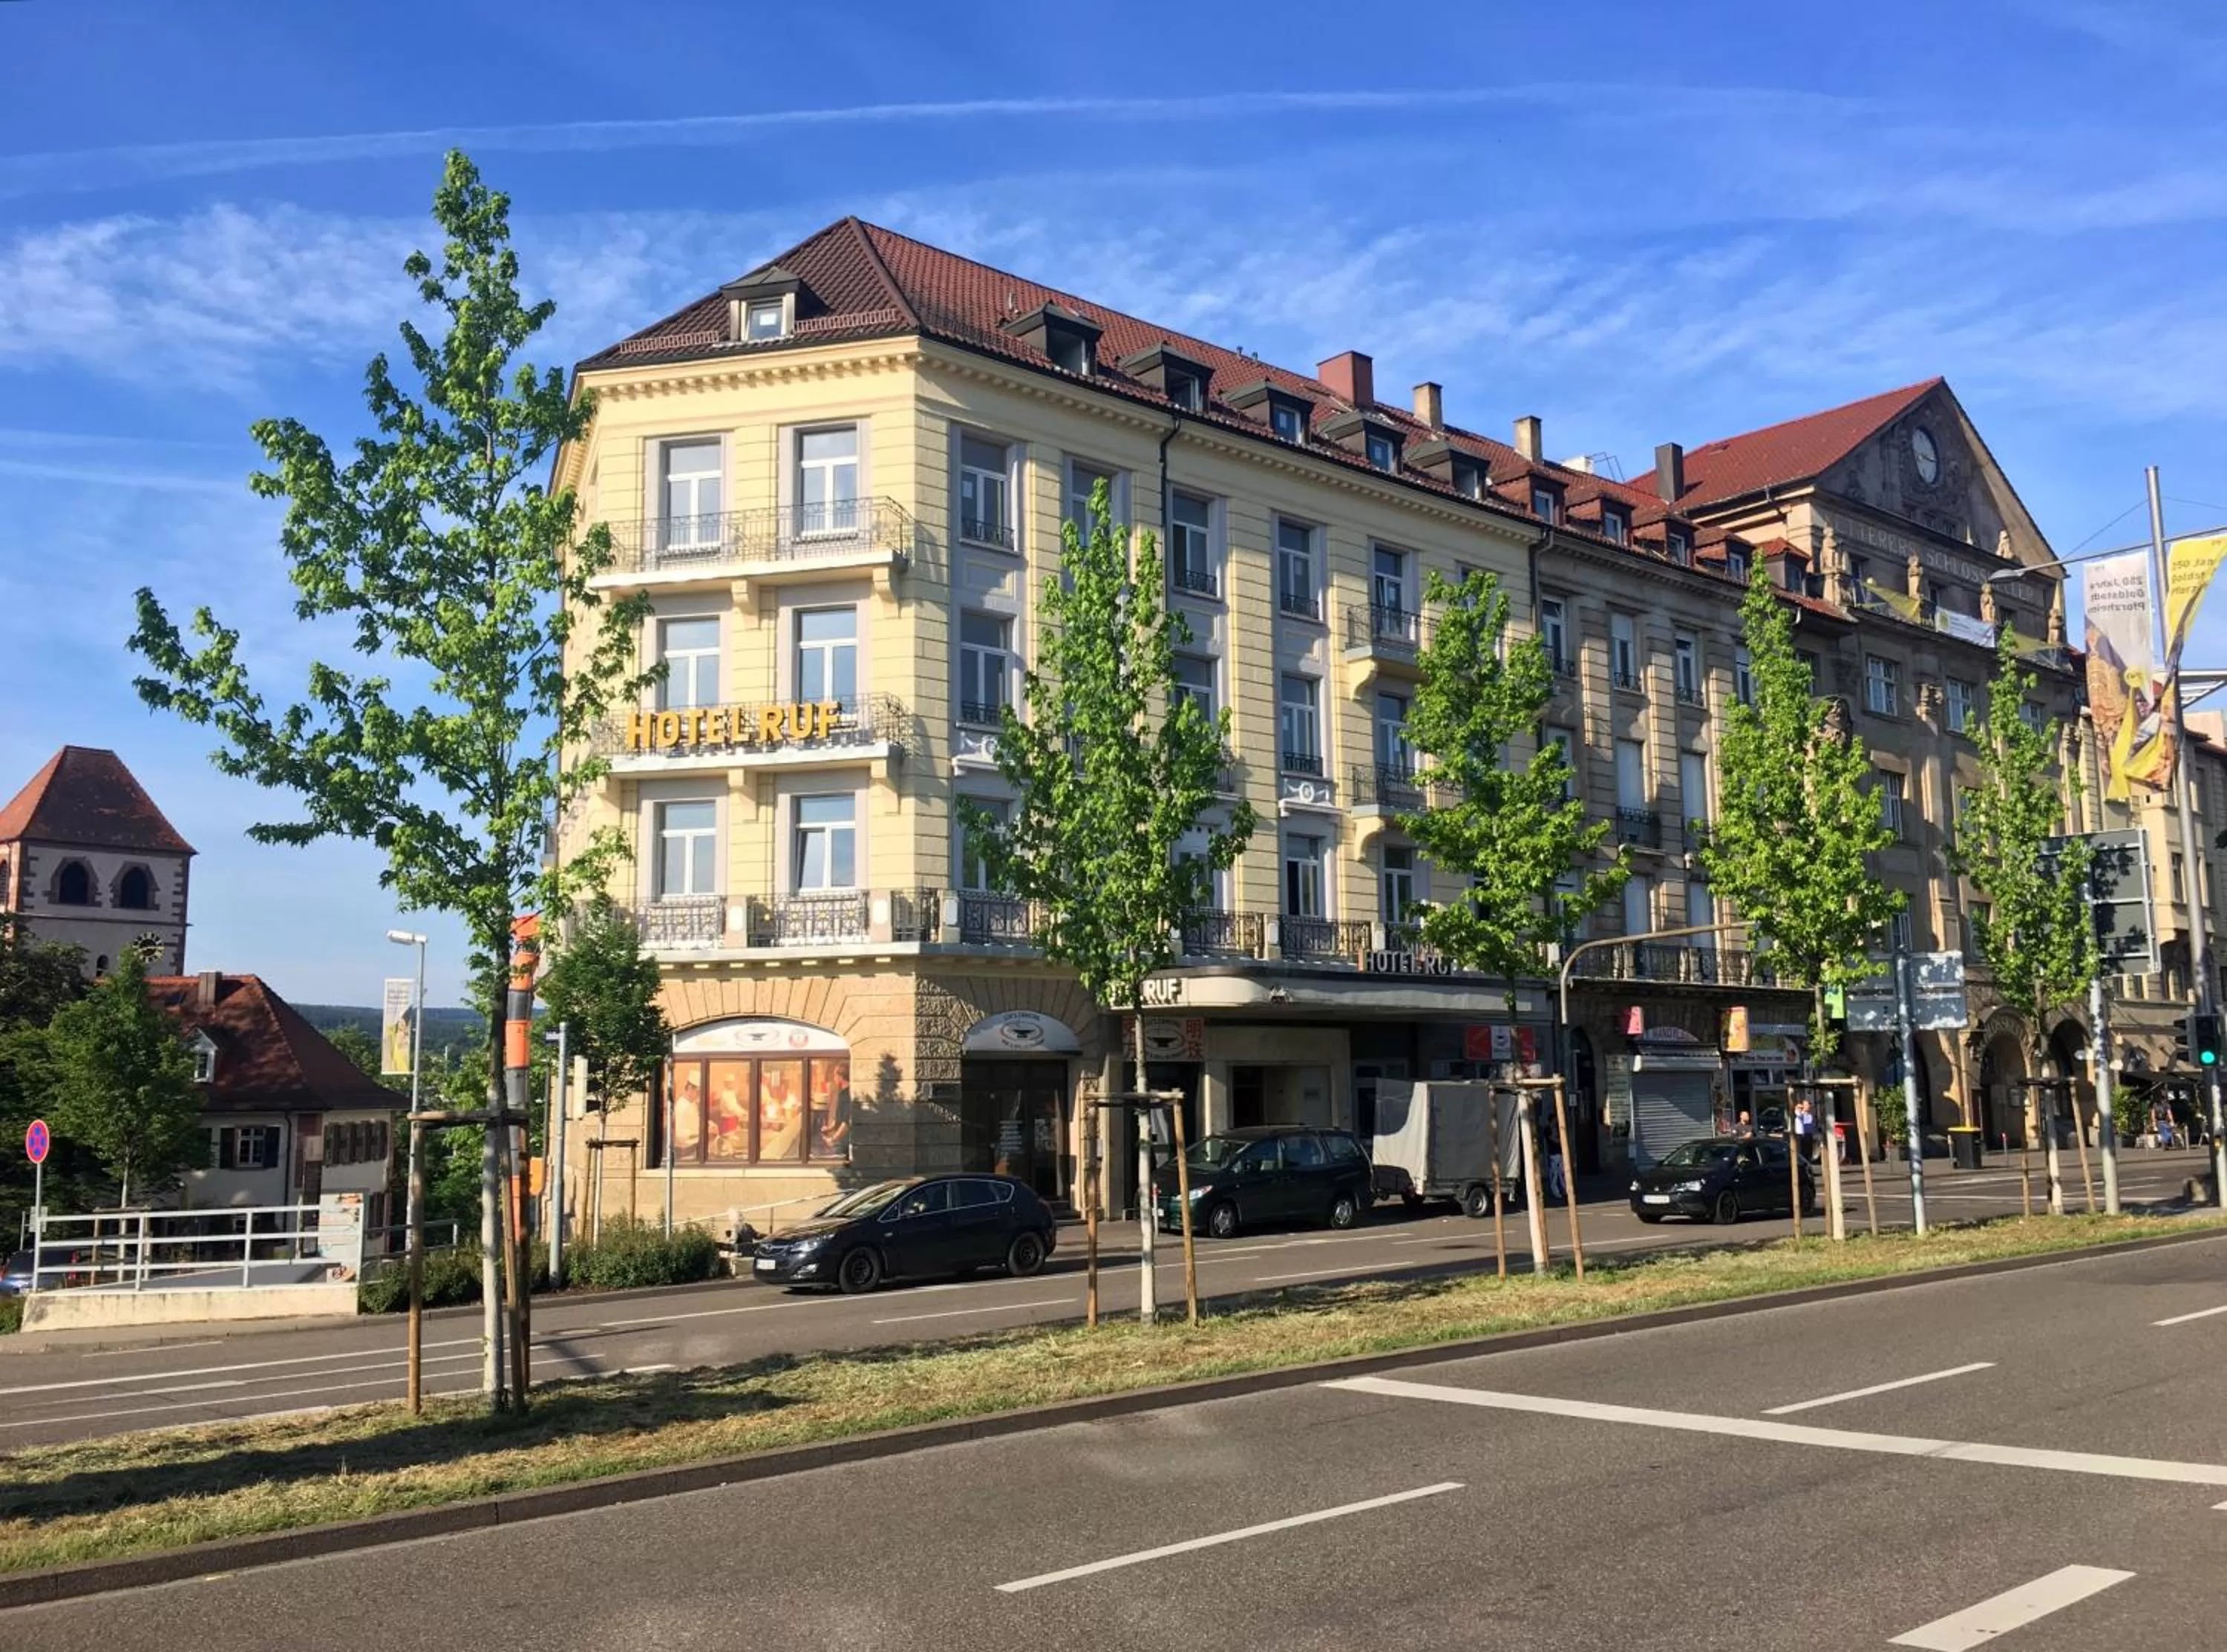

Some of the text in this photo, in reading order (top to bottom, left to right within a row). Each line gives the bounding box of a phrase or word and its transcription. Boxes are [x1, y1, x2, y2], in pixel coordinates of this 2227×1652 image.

[627, 701, 839, 749] HOTEL RUF
[1146, 977, 1178, 1000] RUF
